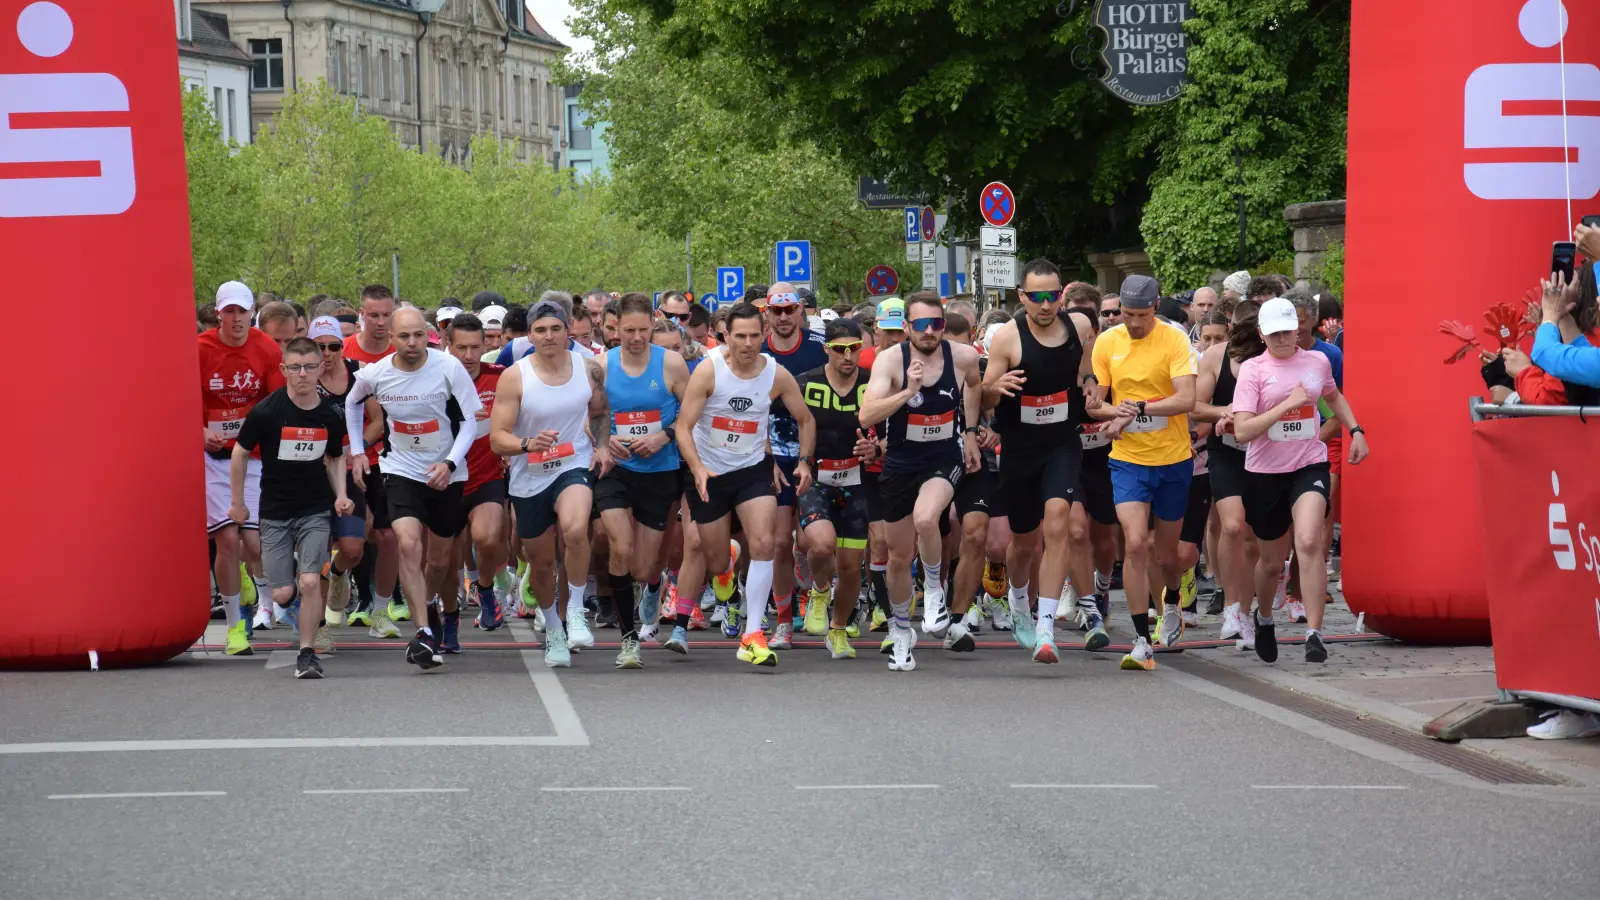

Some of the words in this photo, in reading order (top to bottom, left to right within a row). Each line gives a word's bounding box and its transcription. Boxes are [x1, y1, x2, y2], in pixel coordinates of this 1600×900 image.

[1112, 28, 1188, 54] Bürger
[1117, 52, 1186, 75] Palais
[907, 211, 916, 238] P
[784, 246, 803, 277] P
[987, 257, 1009, 266] Liefer-
[986, 267, 1011, 276] verkehr
[723, 271, 738, 298] P
[993, 276, 1005, 284] frei
[382, 394, 418, 402] Edelmann
[1035, 407, 1055, 417] 209
[1135, 415, 1153, 424] 461
[222, 421, 240, 431] 596
[630, 425, 648, 435] 439
[923, 426, 941, 435] 150
[1283, 422, 1302, 432] 560
[413, 436, 421, 445] 2
[727, 433, 740, 444] 87
[1085, 434, 1098, 443] 74
[294, 442, 314, 452] 474
[542, 460, 562, 470] 576
[831, 470, 849, 481] 416
